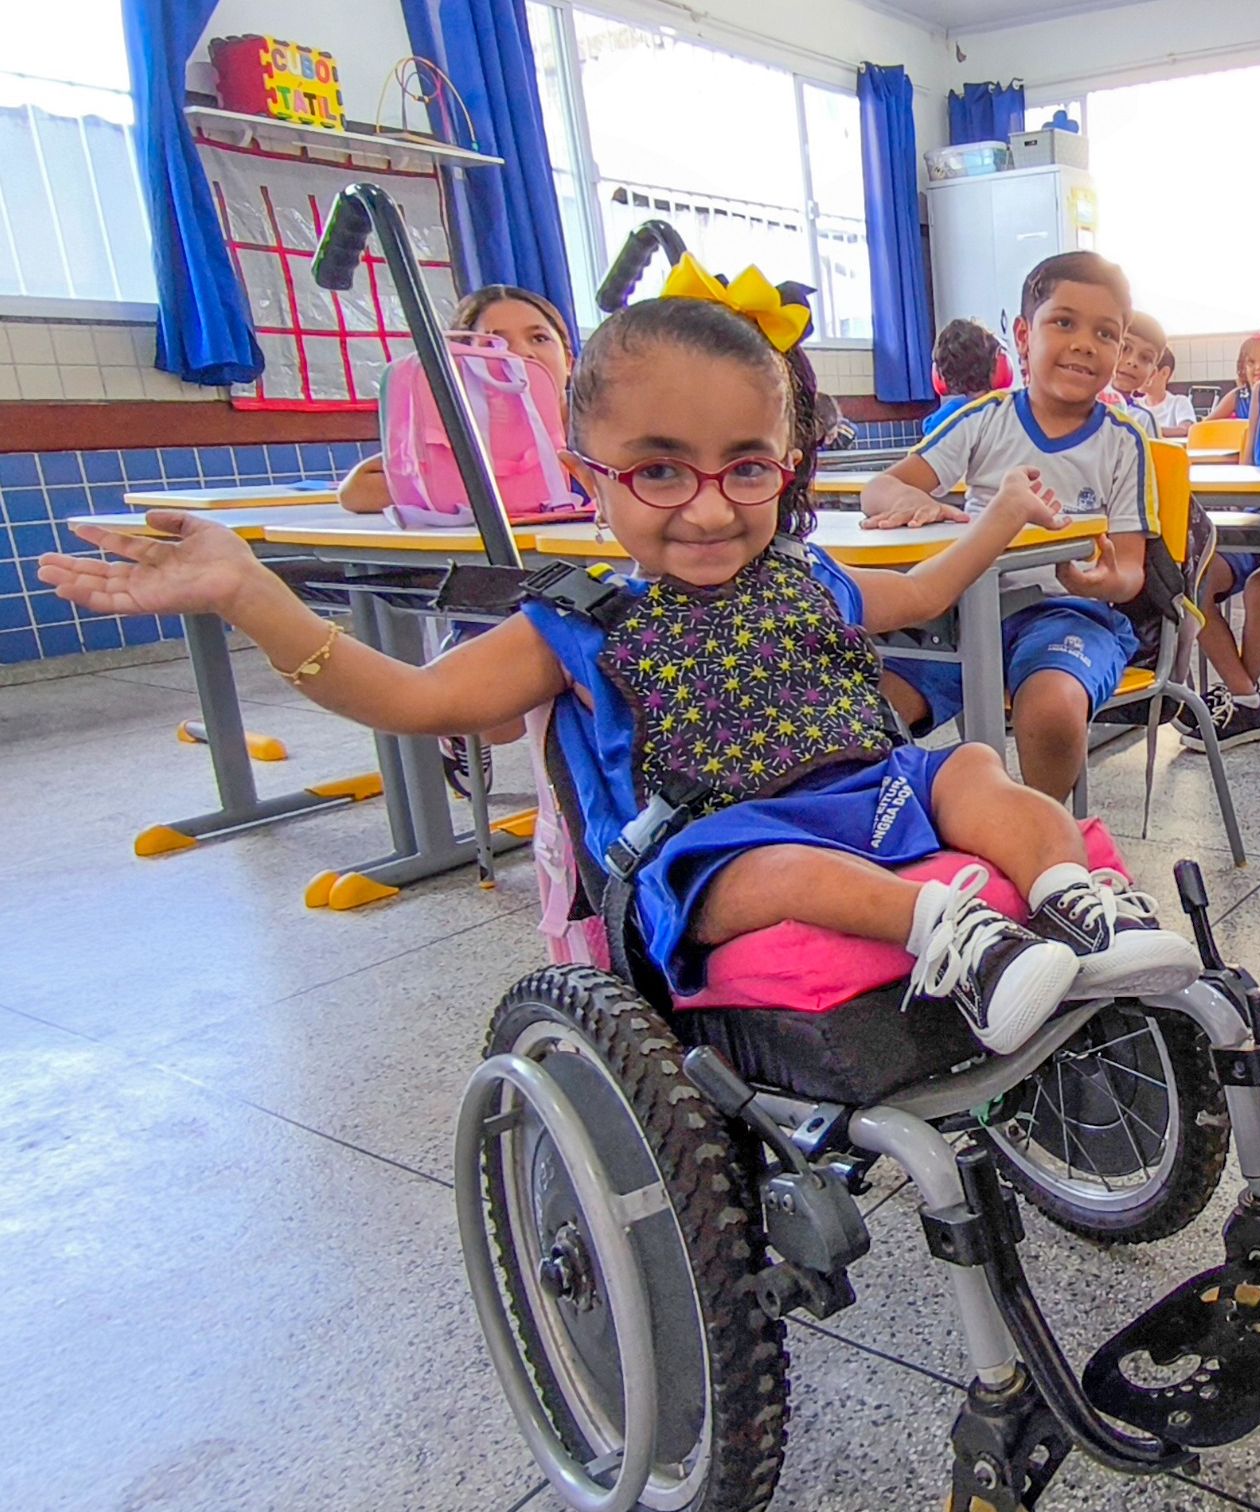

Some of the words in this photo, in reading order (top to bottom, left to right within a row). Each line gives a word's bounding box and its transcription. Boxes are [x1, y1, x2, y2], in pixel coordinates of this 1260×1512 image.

[271, 48, 330, 84] CUBO
[276, 82, 337, 121] TÁTIL
[871, 807, 899, 848] ANGRA
